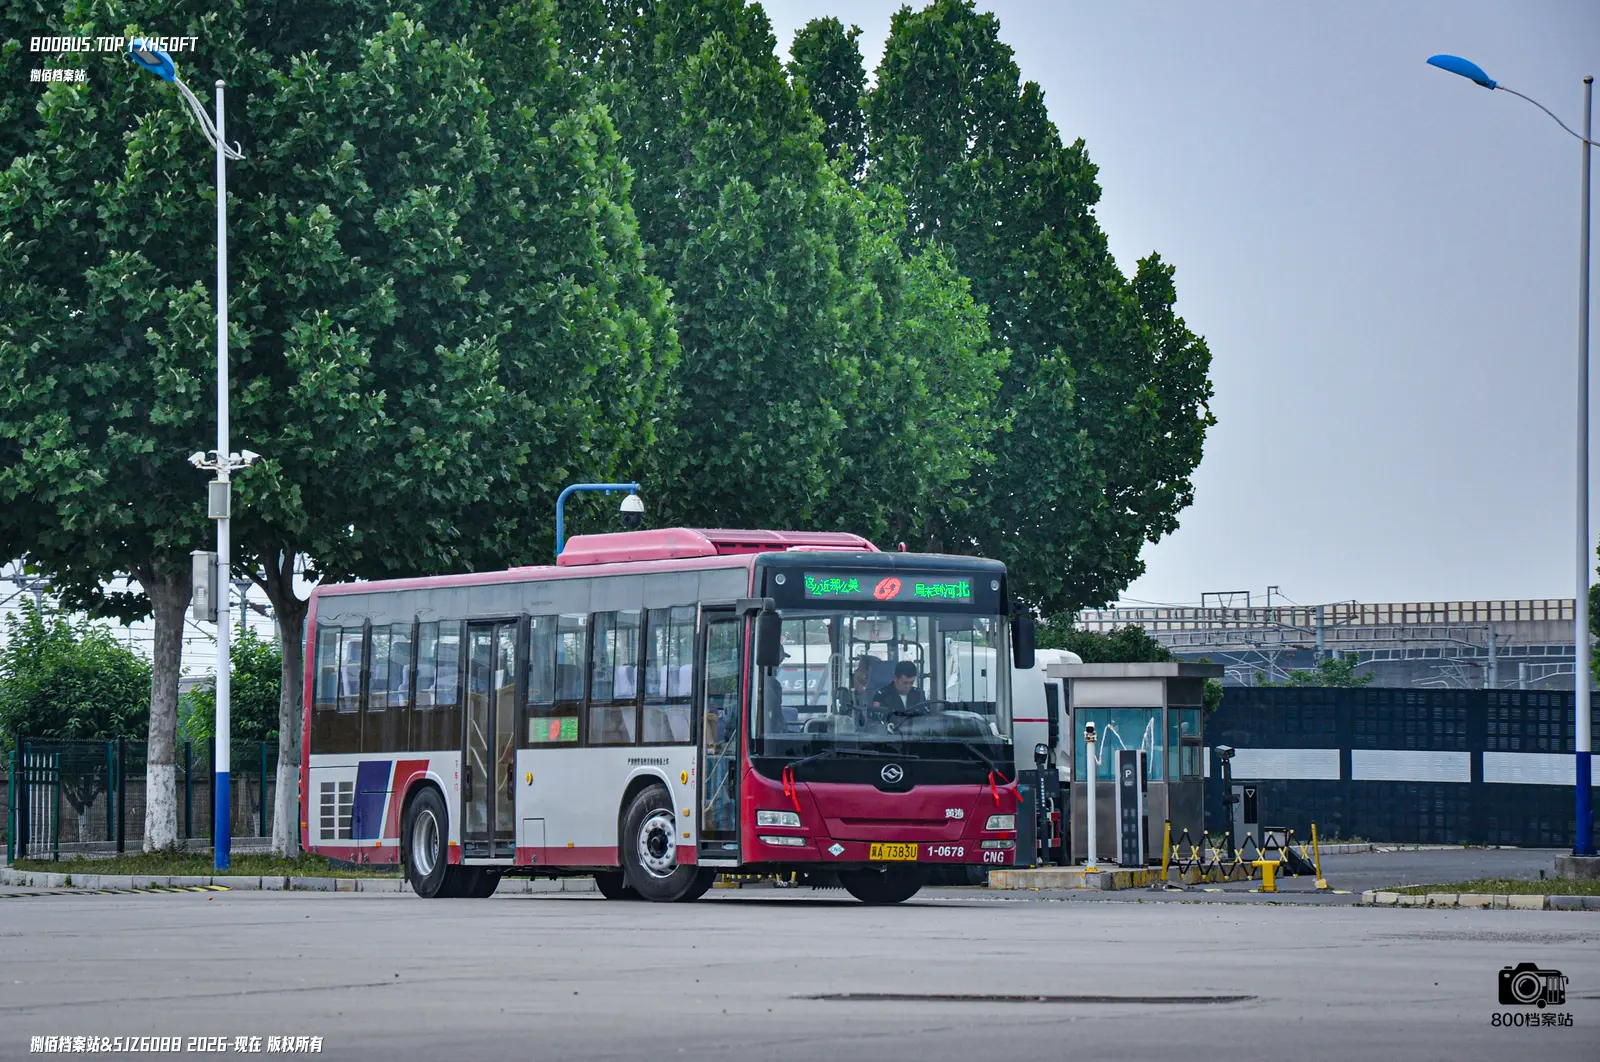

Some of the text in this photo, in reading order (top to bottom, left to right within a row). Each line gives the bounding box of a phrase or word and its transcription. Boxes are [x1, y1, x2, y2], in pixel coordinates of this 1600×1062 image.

[804, 575, 861, 596] 这么近那么美
[913, 579, 971, 599] 周末到河北
[1125, 769, 1132, 778] P
[928, 846, 964, 857] 1-0678
[983, 851, 1005, 863] CNG
